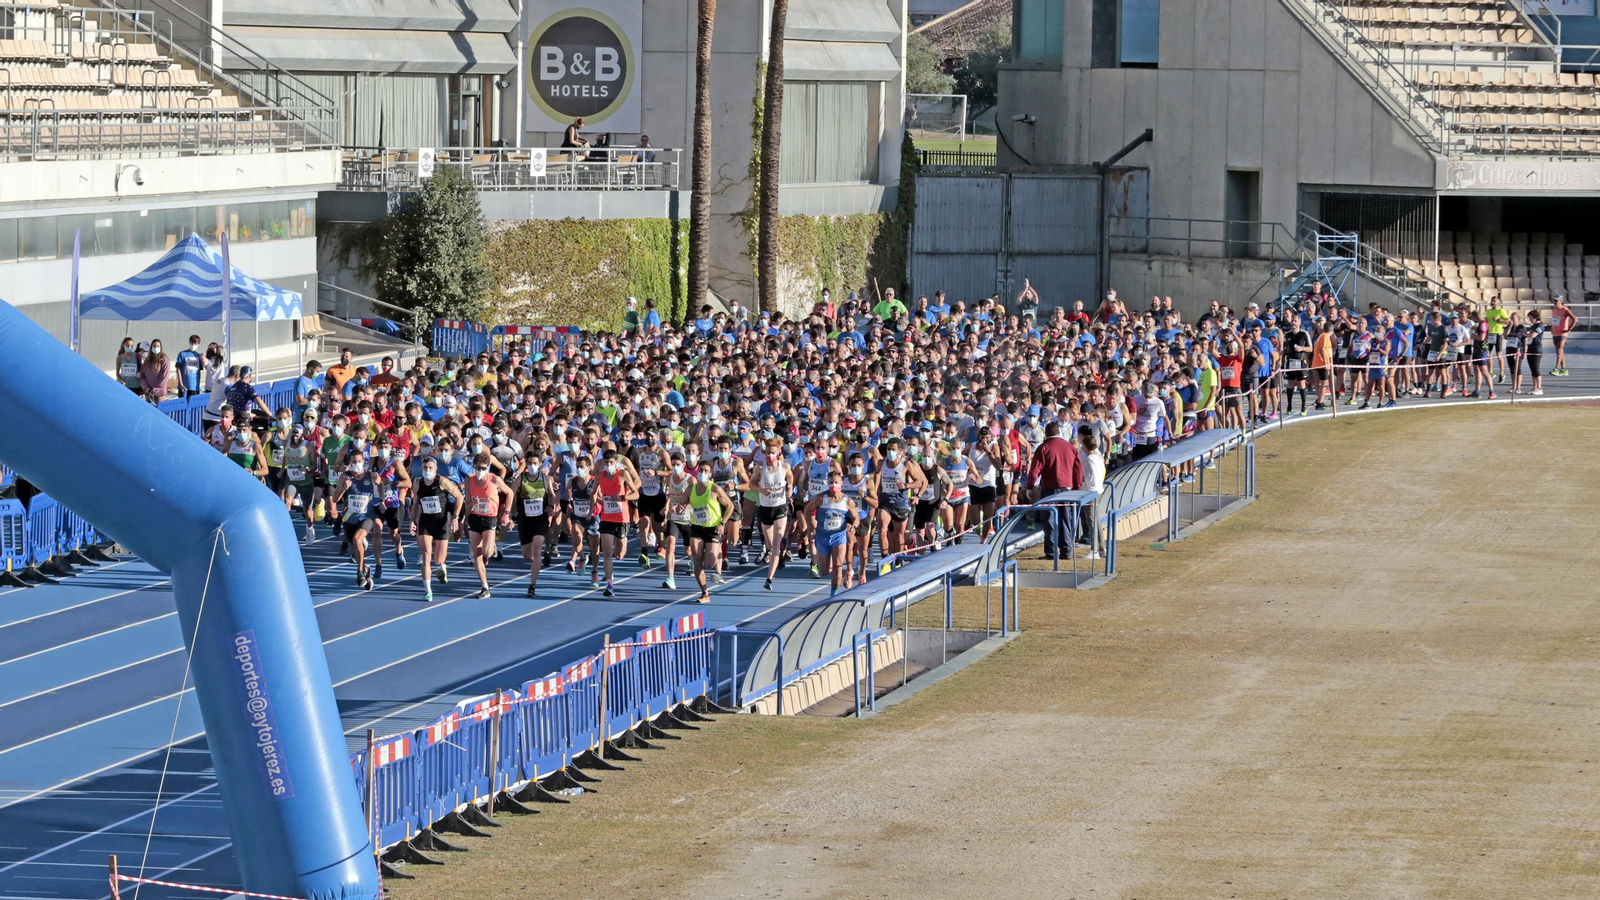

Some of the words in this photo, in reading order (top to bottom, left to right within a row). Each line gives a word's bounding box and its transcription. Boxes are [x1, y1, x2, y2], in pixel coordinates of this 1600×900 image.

[540, 45, 621, 81] B&B
[551, 85, 609, 97] HOTELS
[1478, 163, 1569, 188] Cruzcampo
[235, 636, 286, 796] deportes@aytojerez.es
